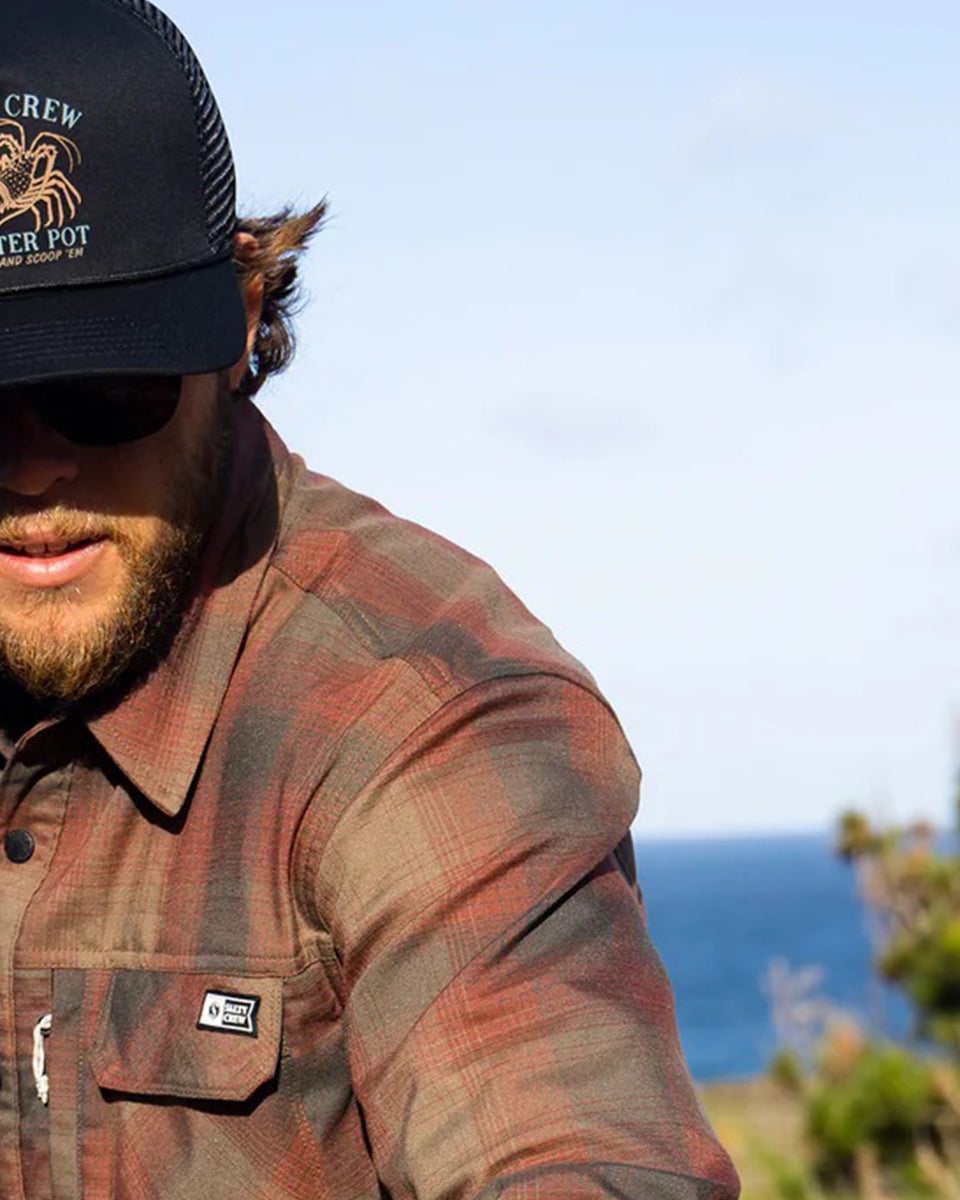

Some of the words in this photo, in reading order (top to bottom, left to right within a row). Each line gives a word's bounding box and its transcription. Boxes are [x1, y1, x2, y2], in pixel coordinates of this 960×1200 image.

[5, 94, 83, 130] CREW
[47, 225, 90, 249] POT
[25, 250, 62, 265] SCOOP
